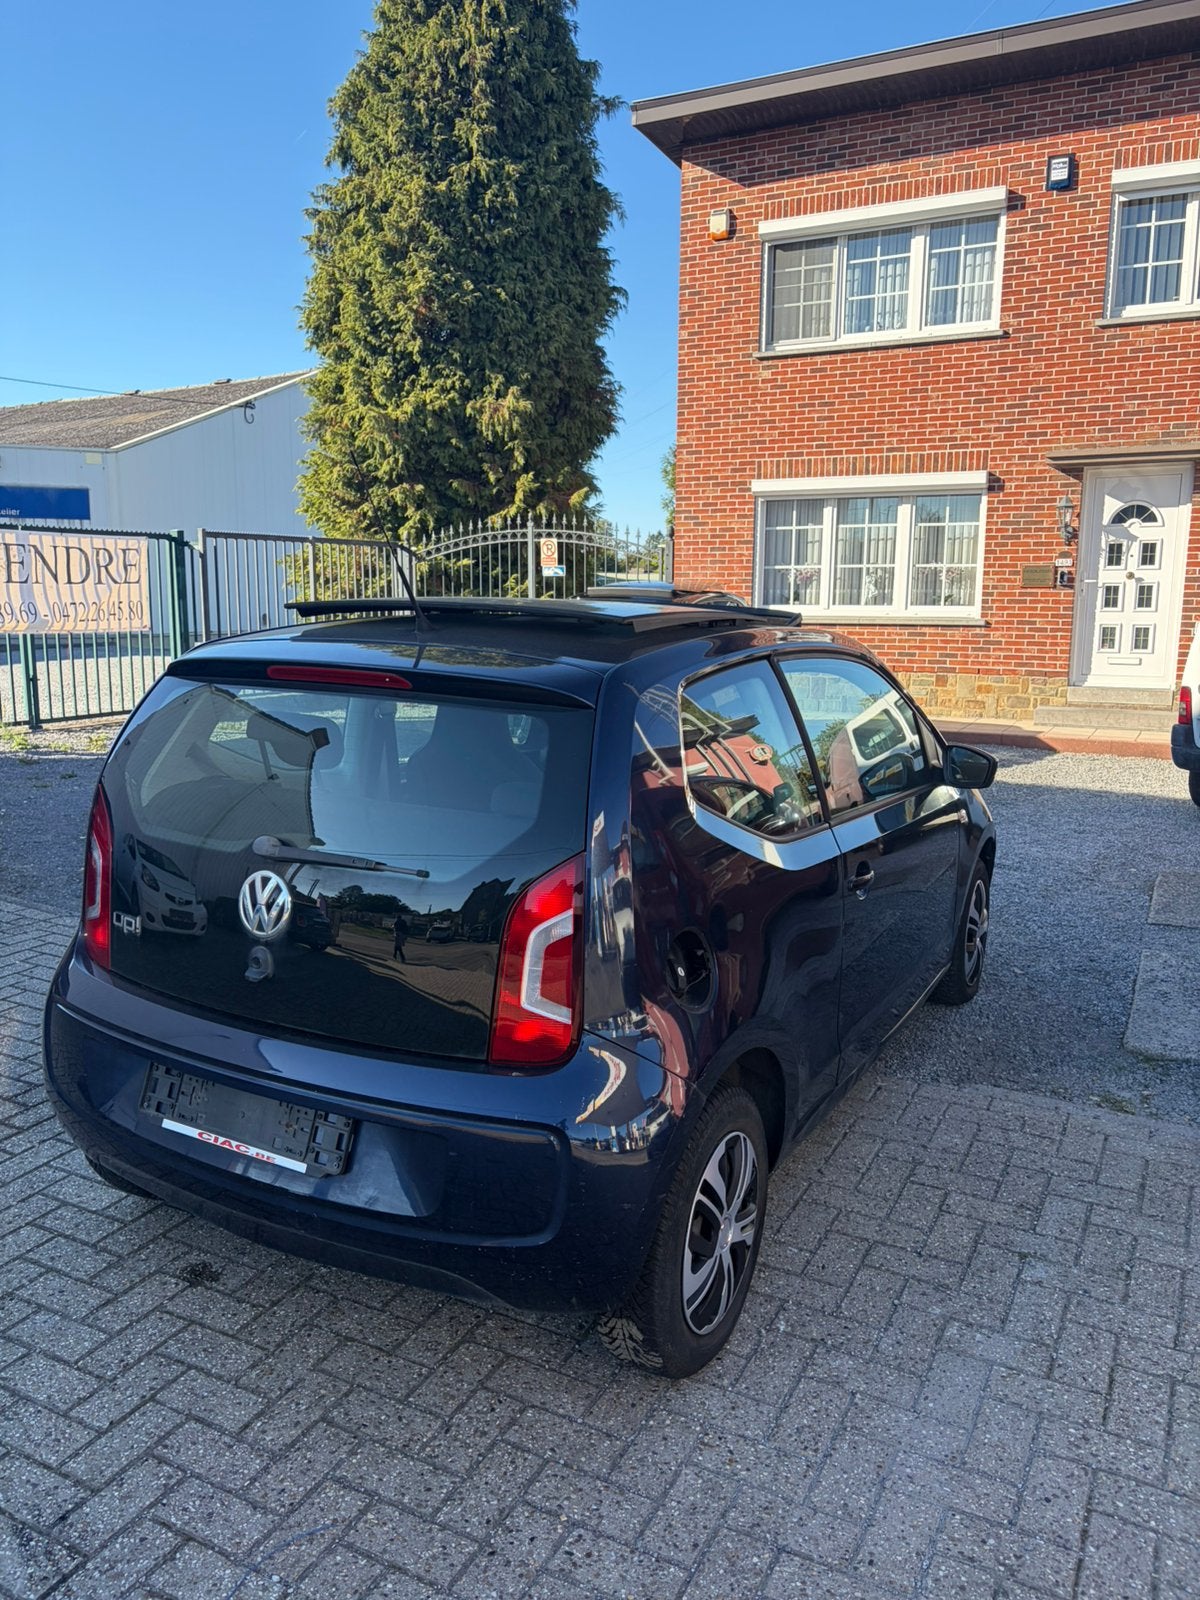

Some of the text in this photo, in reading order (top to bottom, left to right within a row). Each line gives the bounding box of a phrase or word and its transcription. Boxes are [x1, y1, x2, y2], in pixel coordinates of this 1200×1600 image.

[0, 507, 20, 516] elier
[0, 543, 142, 585] ENDRE
[53, 601, 143, 623] 0472.26.45.80
[113, 911, 141, 935] up!
[197, 1131, 276, 1163] CIAC.BE
